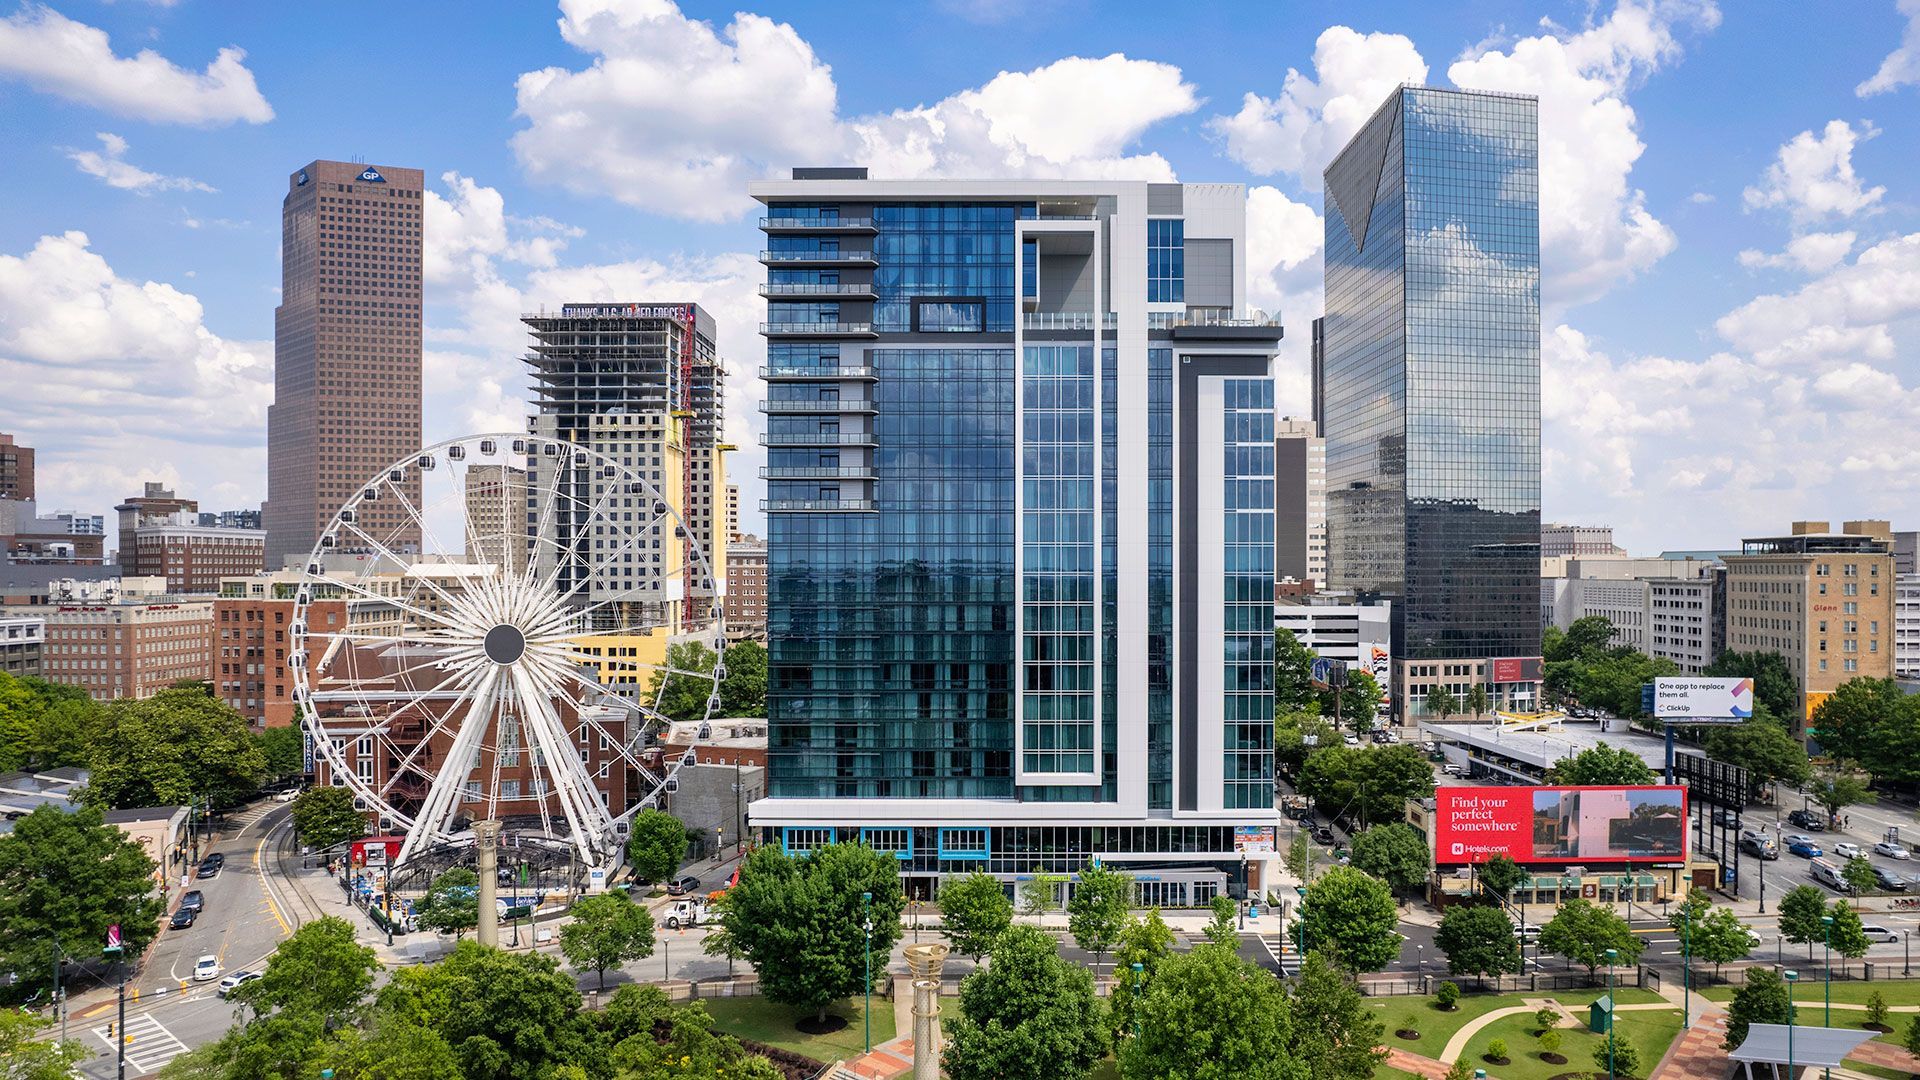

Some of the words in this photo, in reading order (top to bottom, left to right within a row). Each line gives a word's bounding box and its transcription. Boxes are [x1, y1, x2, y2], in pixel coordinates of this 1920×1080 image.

[363, 171, 379, 180] GP
[1813, 604, 1838, 612] Glenn
[1659, 682, 1674, 690] One
[1699, 682, 1725, 691] replace
[1666, 704, 1691, 712] ClickUp
[1451, 796, 1478, 808] Find
[1480, 799, 1508, 811] your
[1451, 807, 1494, 822] perfect
[1451, 820, 1519, 832] somewhere
[1465, 845, 1509, 853] Hotels.com
